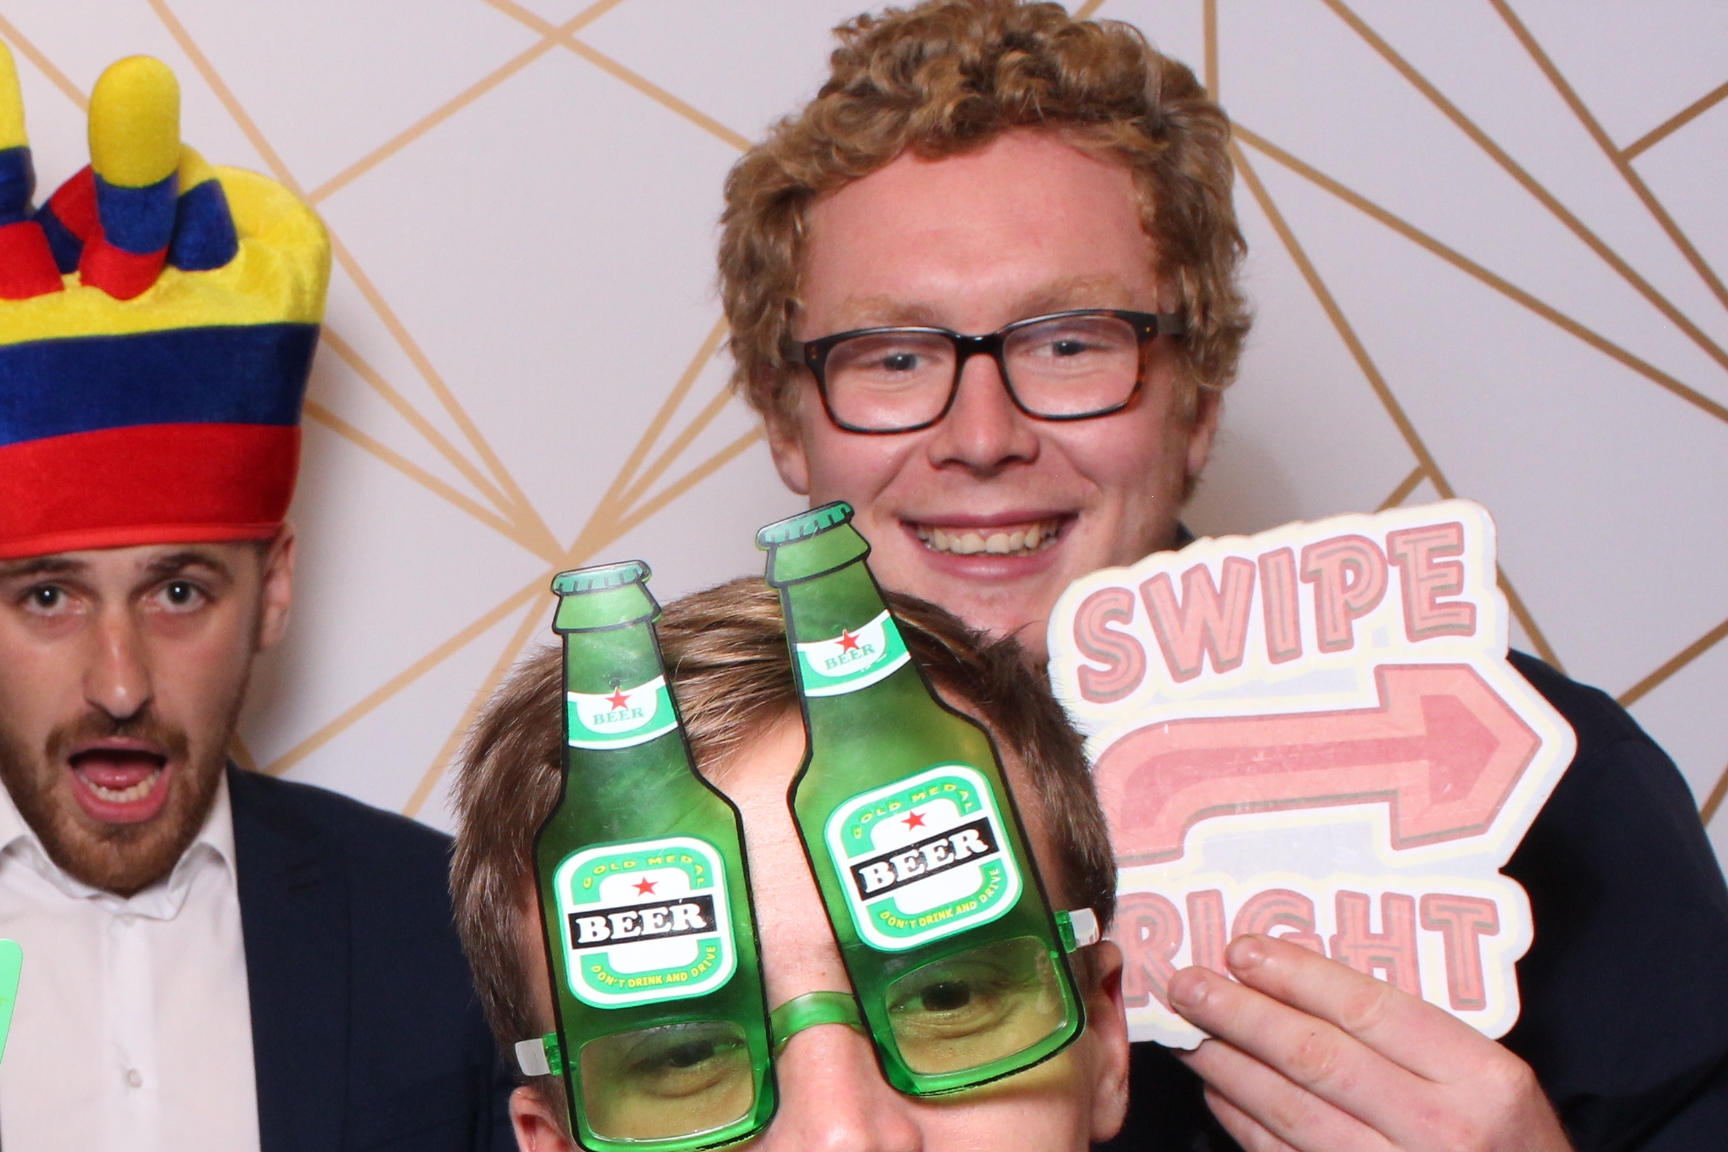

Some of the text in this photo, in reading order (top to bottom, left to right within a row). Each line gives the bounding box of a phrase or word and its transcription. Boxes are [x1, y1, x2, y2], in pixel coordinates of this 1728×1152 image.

[1073, 521, 1476, 704] SWIPE
[824, 643, 876, 671] BEER
[593, 707, 645, 726] BEER
[853, 783, 973, 840] GOLD MEDAL
[582, 855, 706, 889] GOLD MEDAL
[858, 828, 989, 894] BEER
[879, 868, 1002, 929] DON'T DRINK AND DRIVE
[575, 902, 707, 944] BEER
[591, 945, 716, 988] DON'T DRINK AND DRIVE
